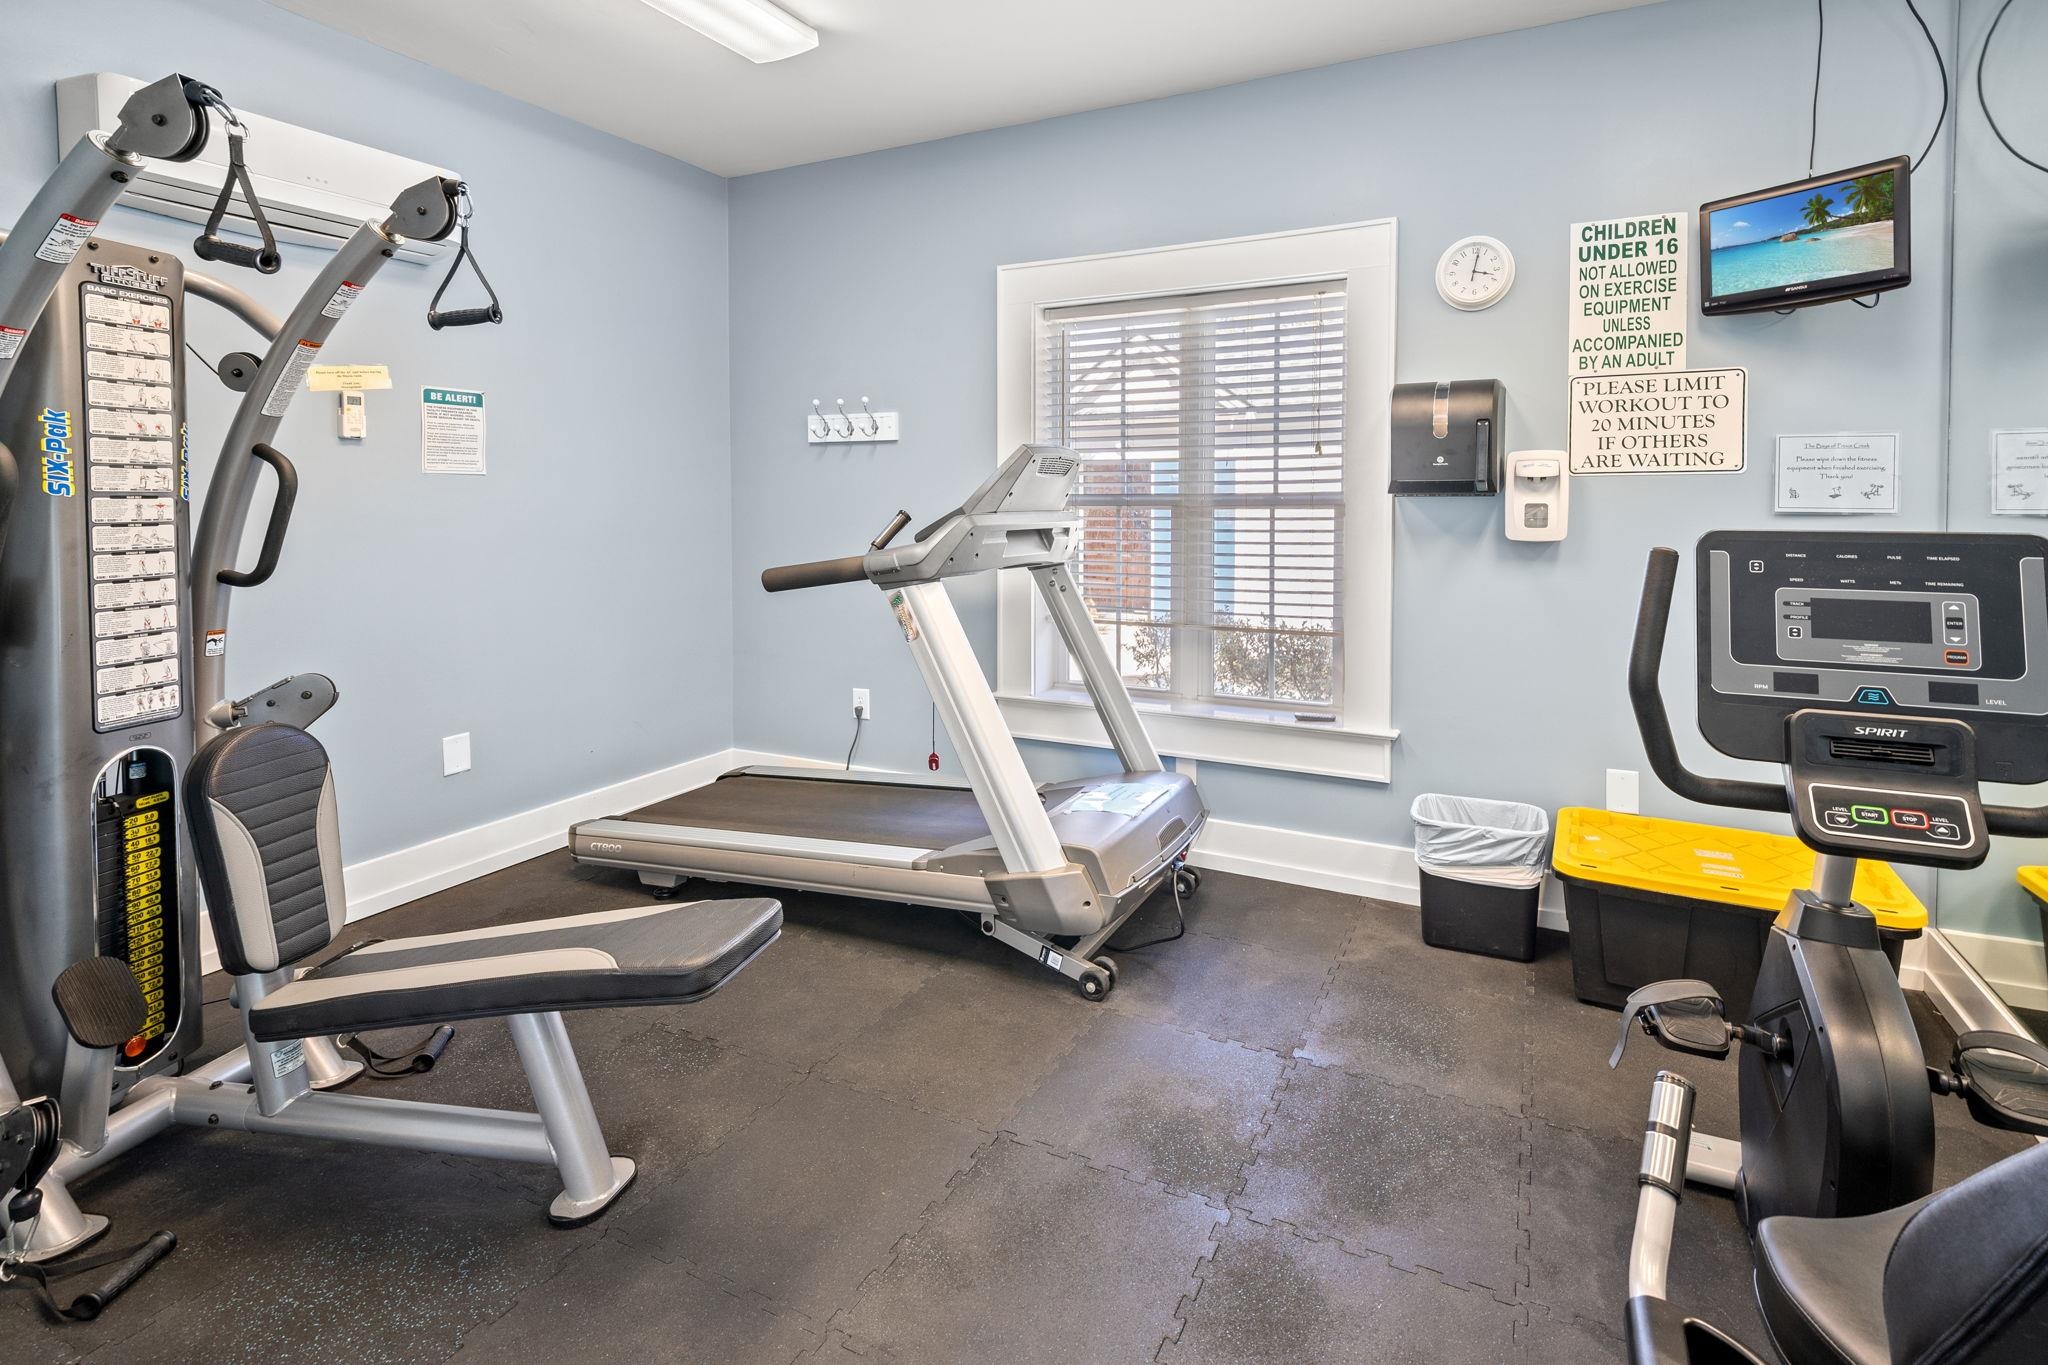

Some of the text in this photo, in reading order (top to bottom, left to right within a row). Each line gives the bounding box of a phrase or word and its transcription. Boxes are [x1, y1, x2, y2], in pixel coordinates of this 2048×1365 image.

[1581, 217, 1676, 243] CHILDREN
[1578, 238, 1679, 262] UNDER 16
[1579, 259, 1677, 281] NOT ALLOWED
[86, 284, 117, 295] BASIC
[119, 290, 168, 305] EXERCISES
[1579, 277, 1677, 299] ON EXERCISE
[1583, 296, 1671, 317] EQUIPMENT
[1603, 316, 1651, 333] UNLESS
[1572, 332, 1684, 353] ACCOMPANIED
[1579, 351, 1675, 370] BY AN ADULT
[1583, 375, 1726, 396] PLEASE LIMIT
[430, 391, 477, 404] BE ALERT!
[1578, 394, 1729, 414] WORKOUT TO
[1591, 413, 1716, 432] 20 MINUTES
[1598, 433, 1708, 450] IF OTHERS
[1581, 451, 1725, 469] ARE WAITING
[1854, 726, 1908, 738] SPIRIT
[1861, 811, 1879, 819] START
